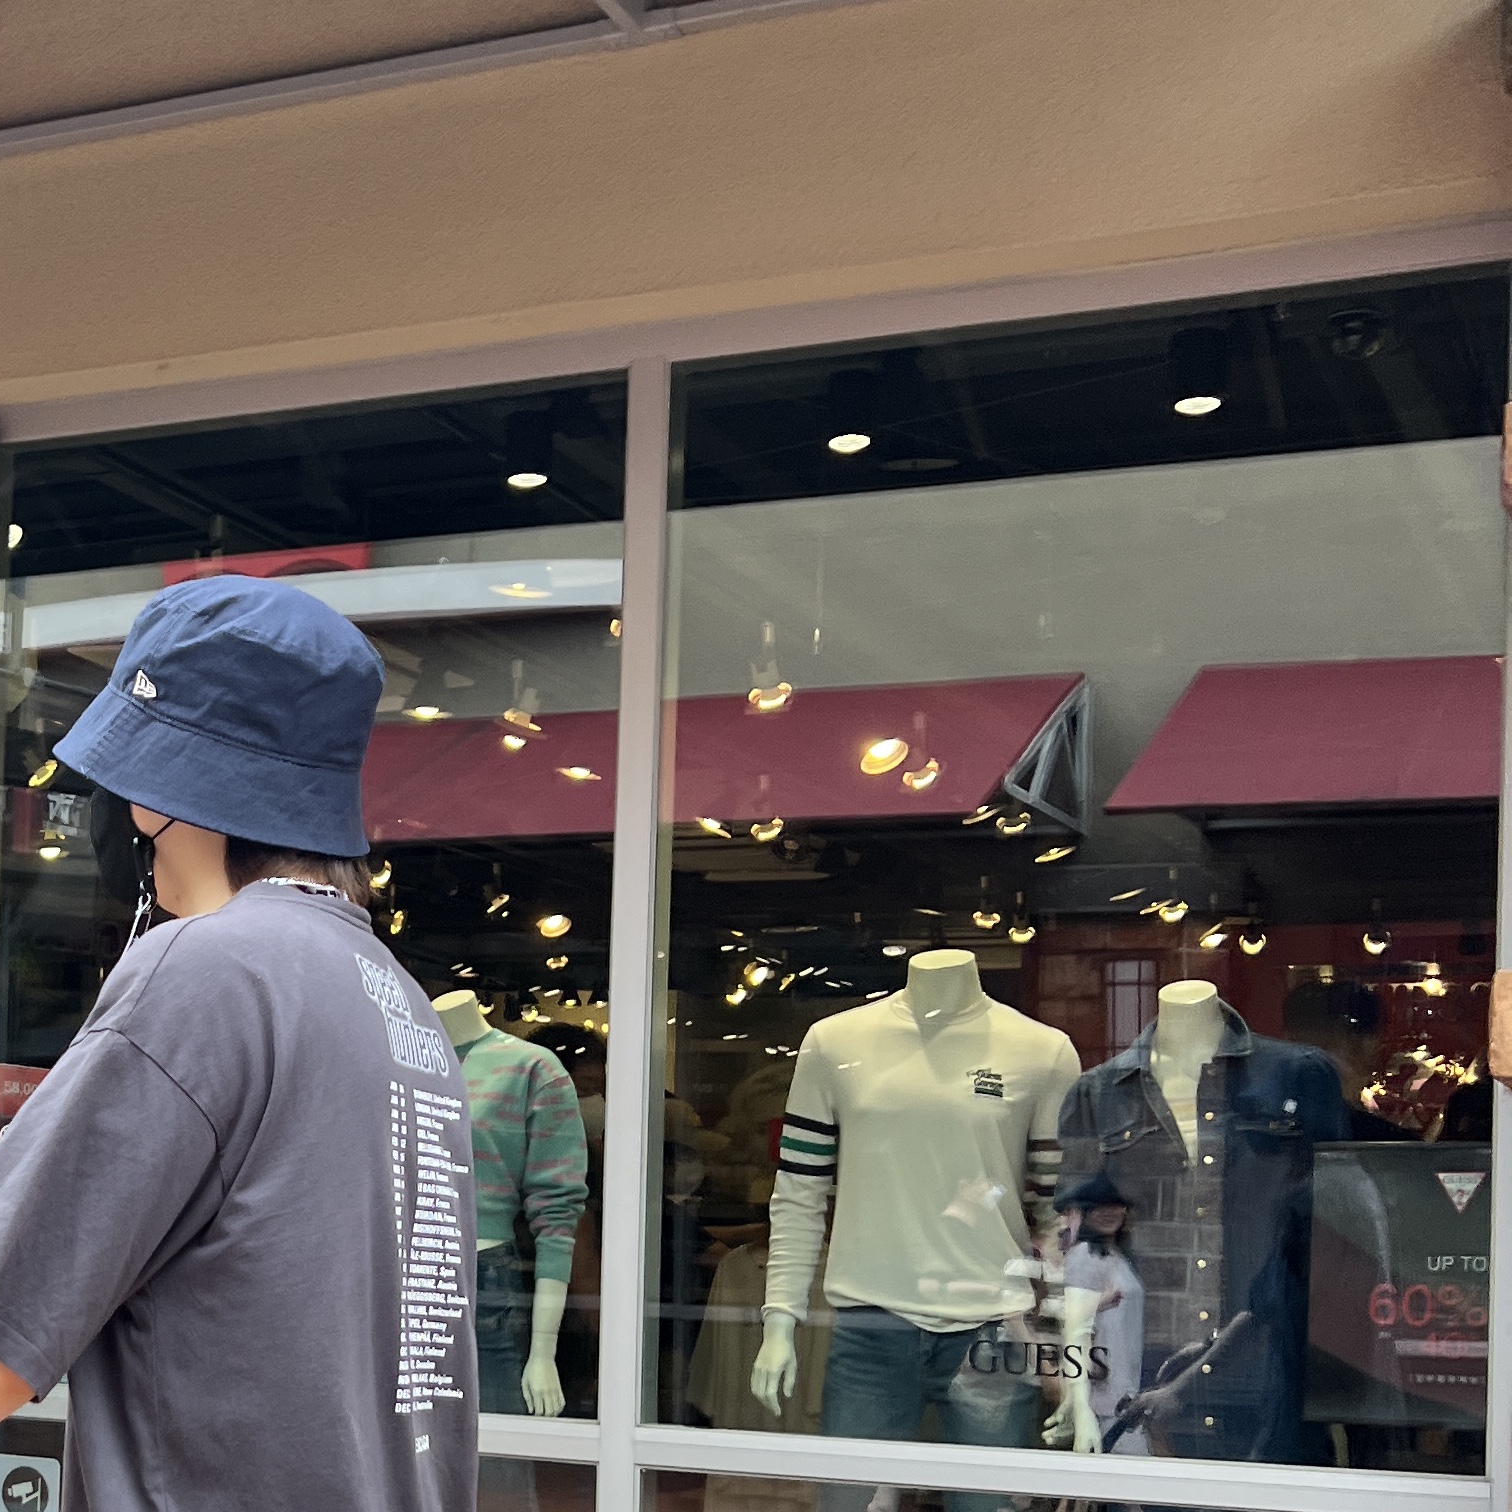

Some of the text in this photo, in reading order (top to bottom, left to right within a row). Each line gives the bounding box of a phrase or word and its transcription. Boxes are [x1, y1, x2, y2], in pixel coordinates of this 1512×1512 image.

[1427, 1255, 1488, 1271] UP TO
[968, 1339, 1111, 1380] GUESS
[394, 1402, 411, 1413] DEC
